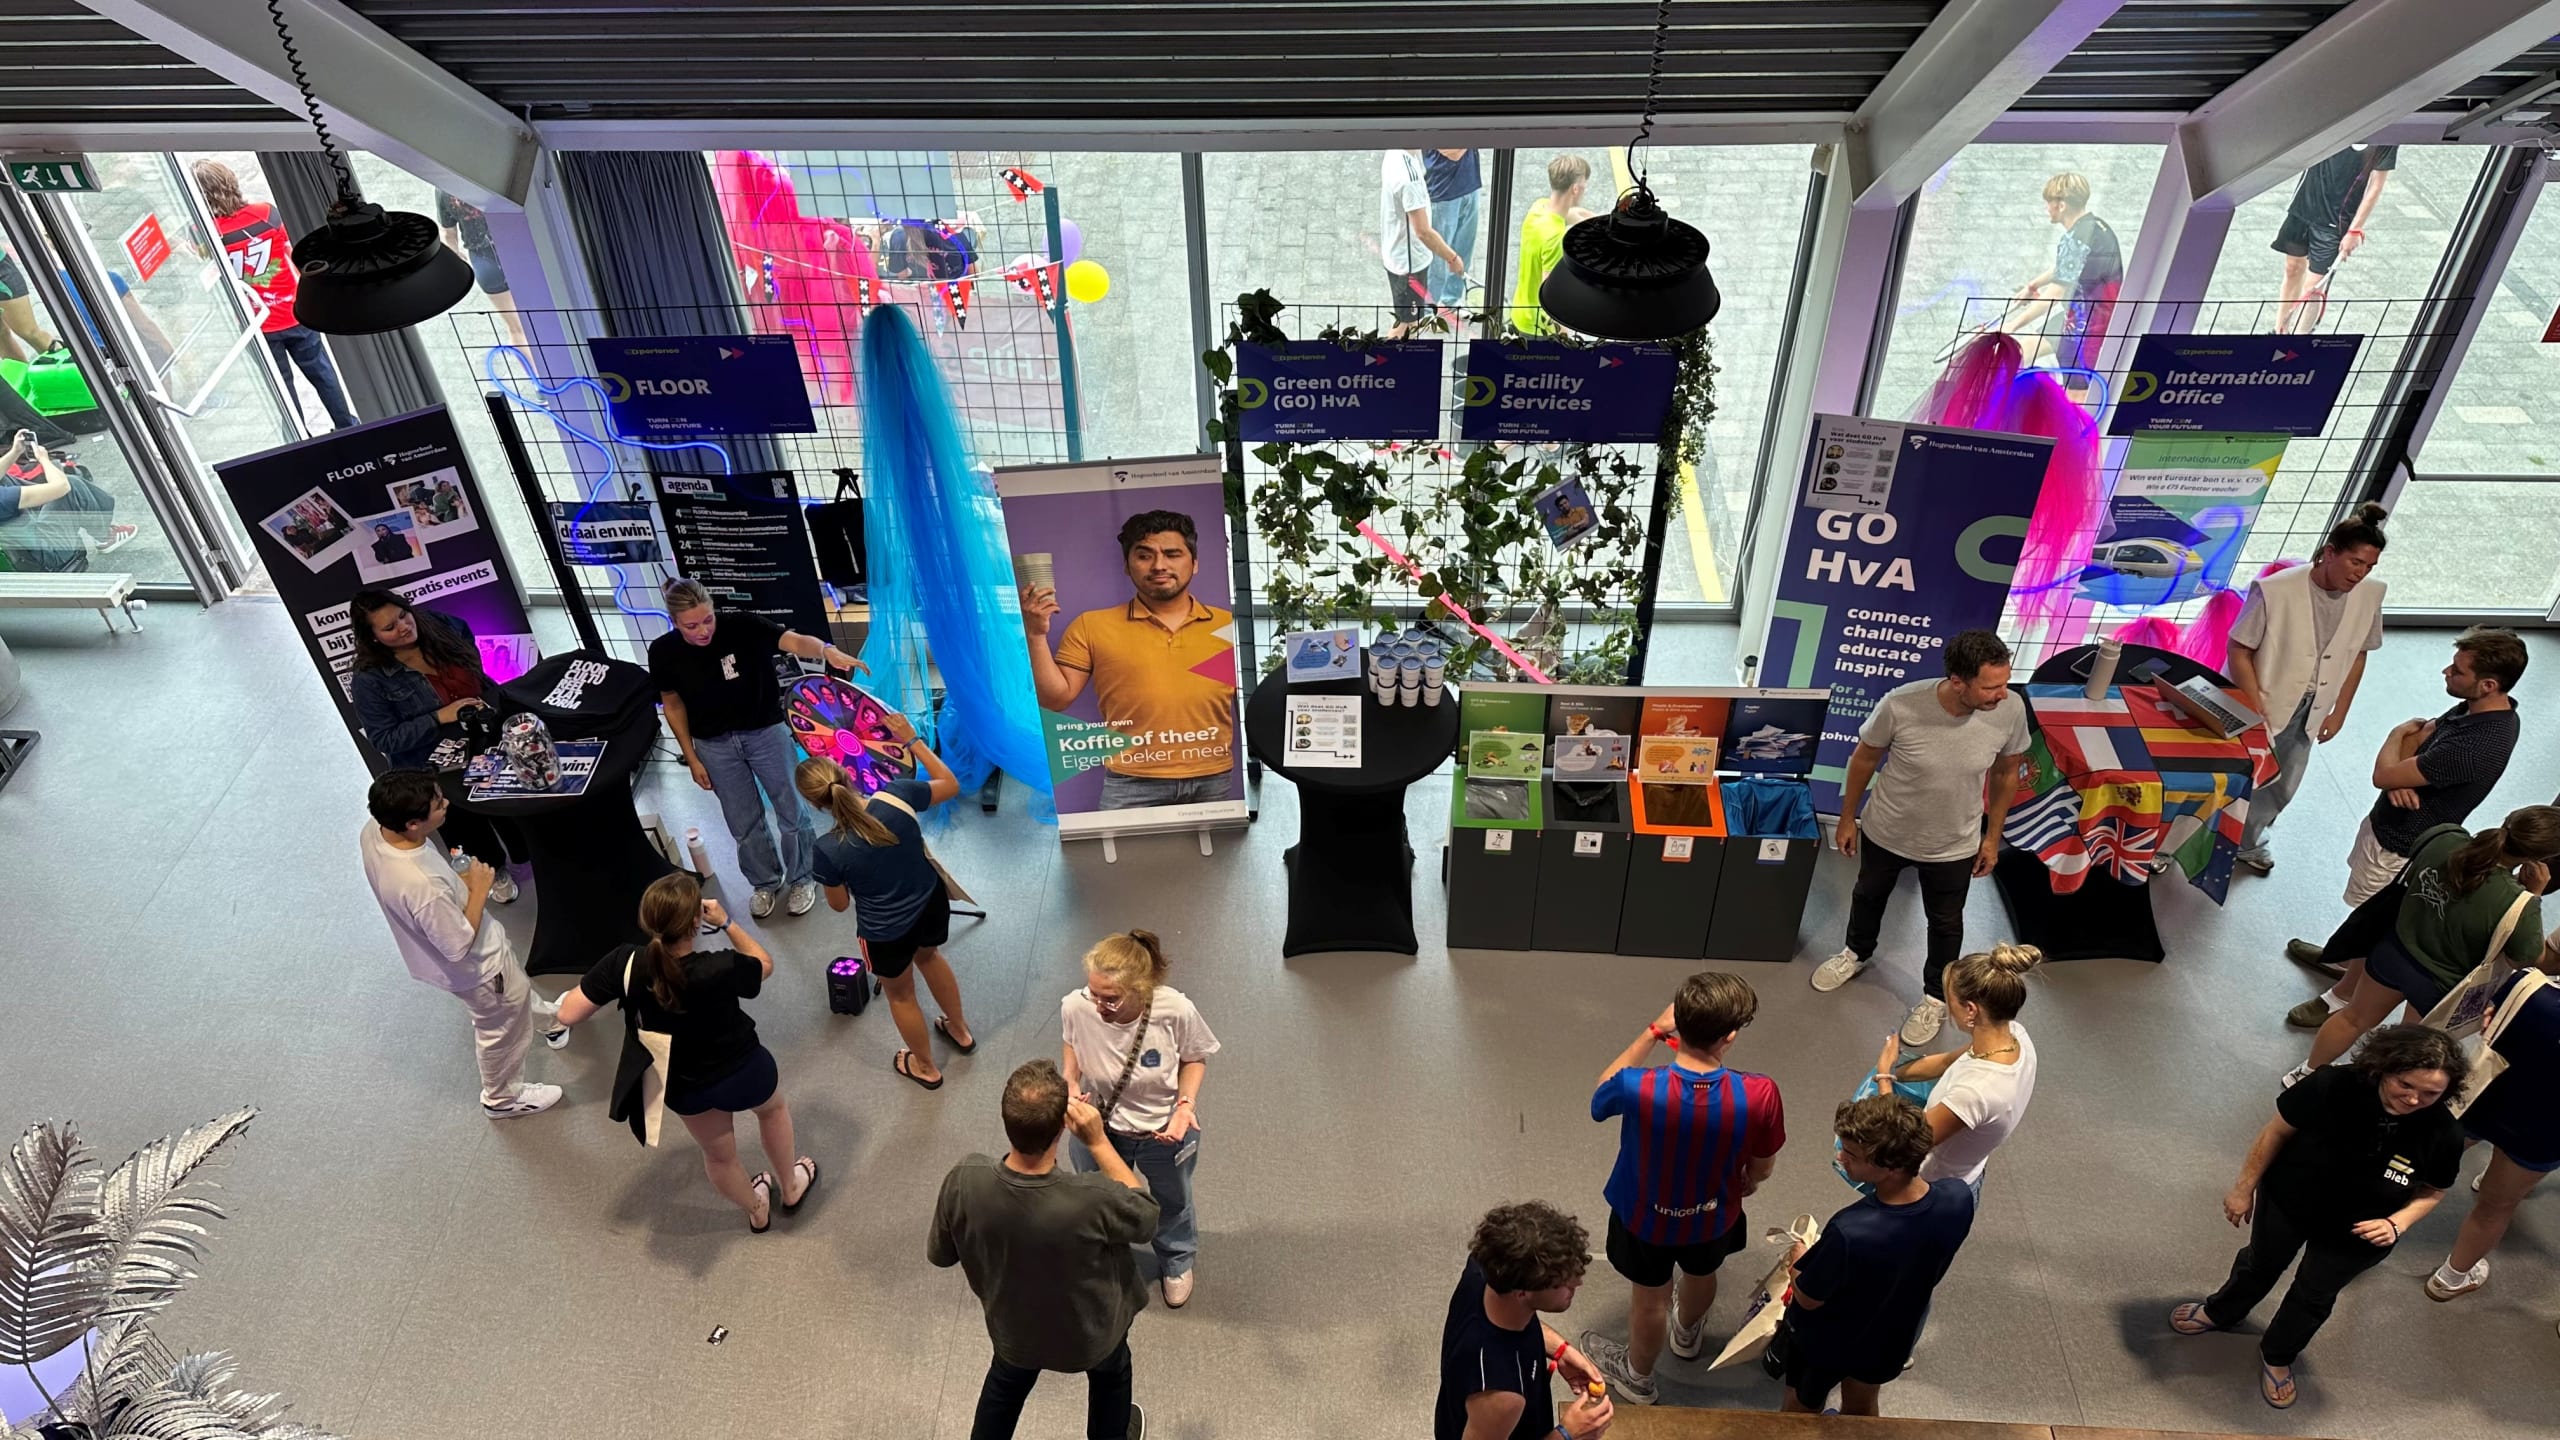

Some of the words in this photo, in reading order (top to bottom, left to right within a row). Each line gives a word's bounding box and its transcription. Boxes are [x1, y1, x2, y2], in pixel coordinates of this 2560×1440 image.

[1273, 376, 1332, 391] Green
[1337, 375, 1396, 389] Office
[1503, 373, 1584, 393] Facility
[2165, 370, 2315, 386] International
[635, 378, 712, 396] FLOOR
[1274, 395, 1316, 411] (GO)
[1321, 394, 1361, 408] HvA
[1500, 394, 1592, 411] Services
[2159, 389, 2225, 405] Office
[1929, 440, 1973, 451] Hogeschool
[1989, 448, 2035, 459] Amsterdam
[2158, 455, 2221, 464] International
[2222, 456, 2250, 465] Office
[326, 461, 377, 482] FLOOR
[2164, 474, 2200, 482] Eurostar
[2202, 475, 2219, 483] bon
[668, 479, 709, 492] agenda
[675, 508, 682, 518] 4
[561, 524, 598, 540] draai
[598, 526, 618, 539] en
[619, 522, 653, 538] win:
[675, 525, 687, 535] 18
[1816, 508, 1898, 545] GO
[679, 540, 692, 550] 24
[684, 555, 697, 565] 25
[688, 571, 701, 581] 29
[1805, 548, 1916, 591] HvA
[403, 580, 443, 603] gratis
[443, 567, 490, 588] events
[1847, 608, 1931, 628] connect
[326, 635, 348, 650] bij
[1843, 624, 1943, 649] challenge
[1838, 642, 1922, 663] educate
[569, 659, 610, 675] FLOOR
[1834, 658, 1905, 679] inspire
[1856, 688, 1866, 696] a
[1829, 696, 1878, 708] sustai
[1056, 722, 1084, 732] Bring
[1085, 720, 1109, 731] your
[1111, 719, 1134, 727] own
[1059, 734, 1125, 752] Koffie
[1131, 730, 1154, 746] of
[1159, 726, 1220, 745] thee?
[1061, 752, 1114, 771] Eigen
[1119, 748, 1176, 764] beker
[1181, 743, 1230, 760] mee!
[2383, 1168, 2409, 1186] Bieb
[1654, 1203, 1703, 1218] unicef
